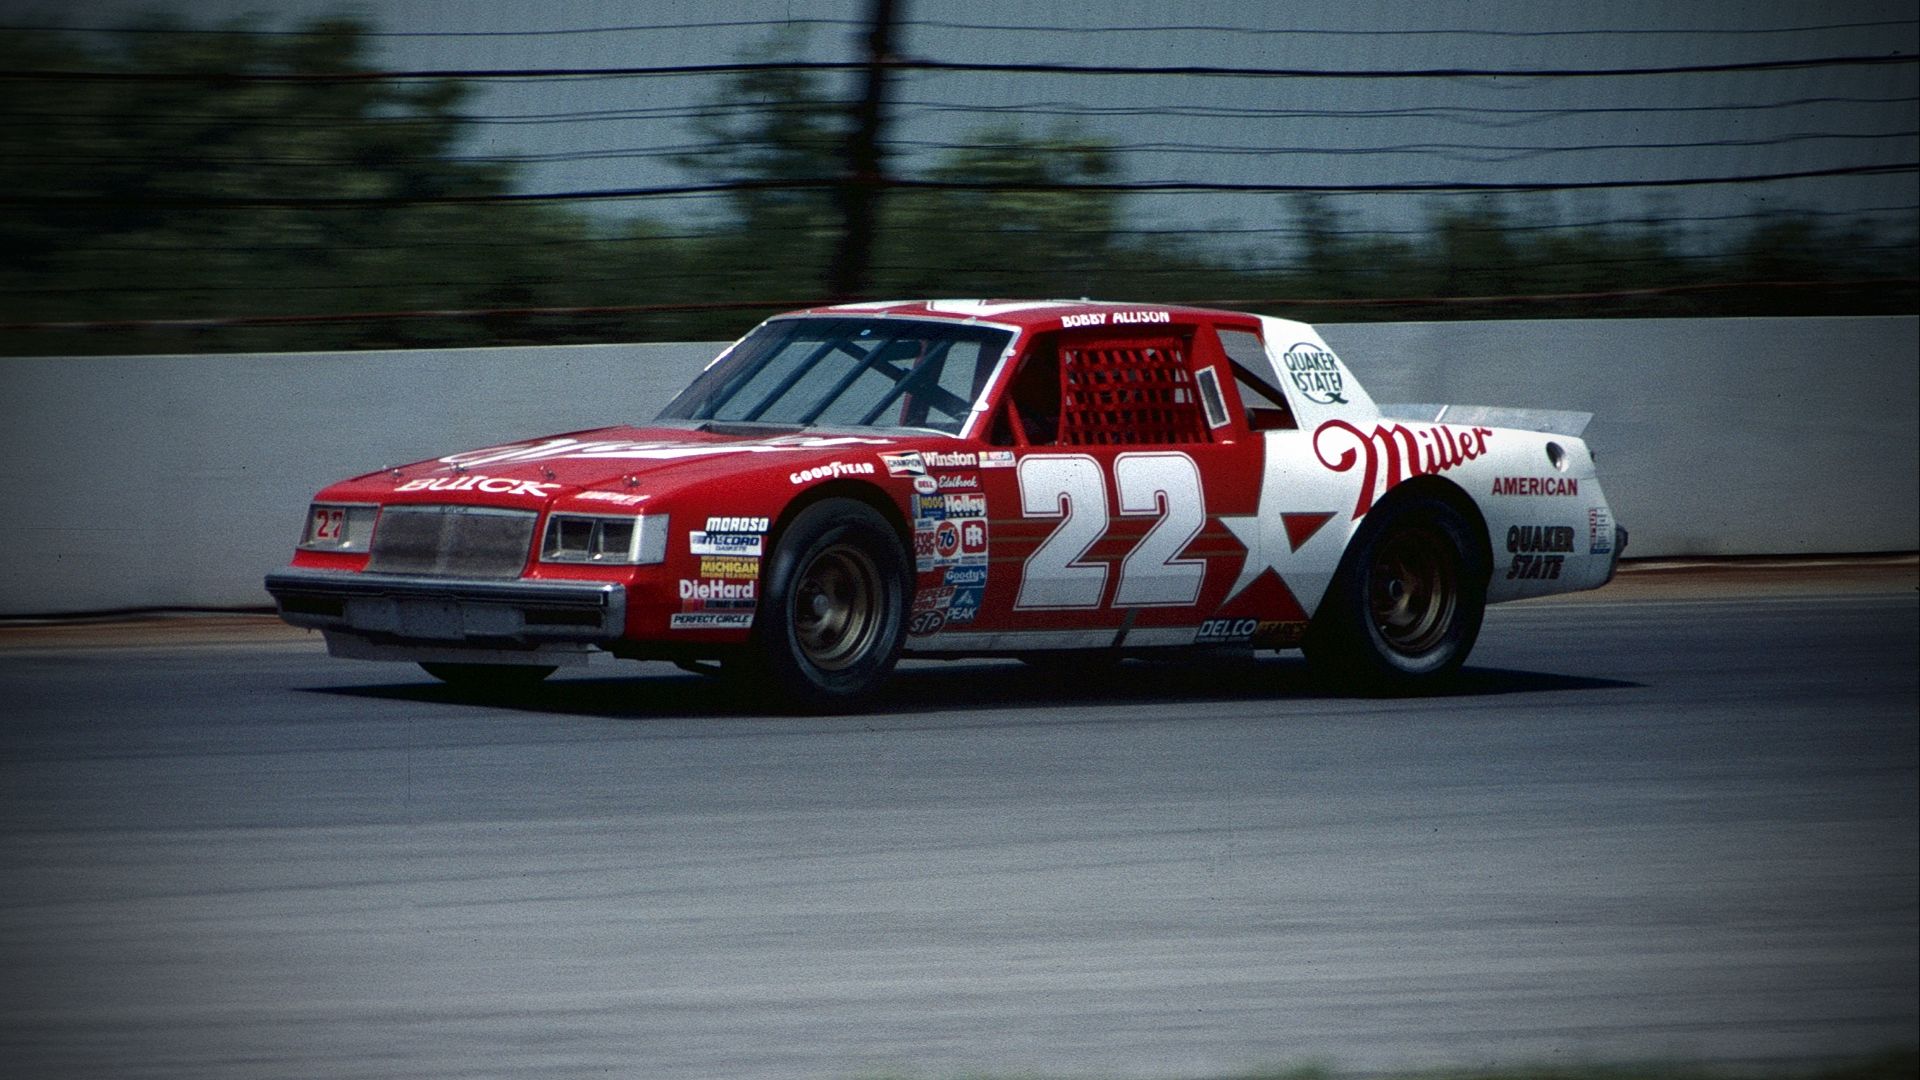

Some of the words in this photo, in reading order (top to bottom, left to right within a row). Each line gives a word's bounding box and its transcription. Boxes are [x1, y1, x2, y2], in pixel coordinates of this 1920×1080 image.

[1061, 313, 1106, 328] BOBBY
[1113, 311, 1170, 324] ALLISON
[1283, 352, 1338, 371] QUAKER
[1298, 373, 1337, 392] STATE
[887, 458, 922, 468] CHAMPION
[922, 451, 977, 466] Winston
[790, 461, 875, 484] GOODYEAR
[1312, 419, 1493, 521] Miller
[394, 475, 562, 497] BUICK
[939, 475, 978, 488] Edelbrock
[1492, 477, 1578, 496] AMERICAN
[945, 494, 985, 516] Holley
[706, 517, 769, 531] MOROSO
[1013, 451, 1207, 611] 22
[939, 528, 957, 549] 76
[1506, 525, 1575, 553] QUAKER
[701, 561, 759, 574] MICHIGAN
[946, 569, 985, 580] Goody's
[1506, 555, 1565, 580] STATE
[680, 579, 755, 599] DieHard
[674, 613, 716, 623] PERFECT
[717, 613, 750, 623] CIRCLE
[911, 612, 942, 632] STP
[948, 607, 977, 619] PEAK
[1198, 620, 1258, 636] DELCO
